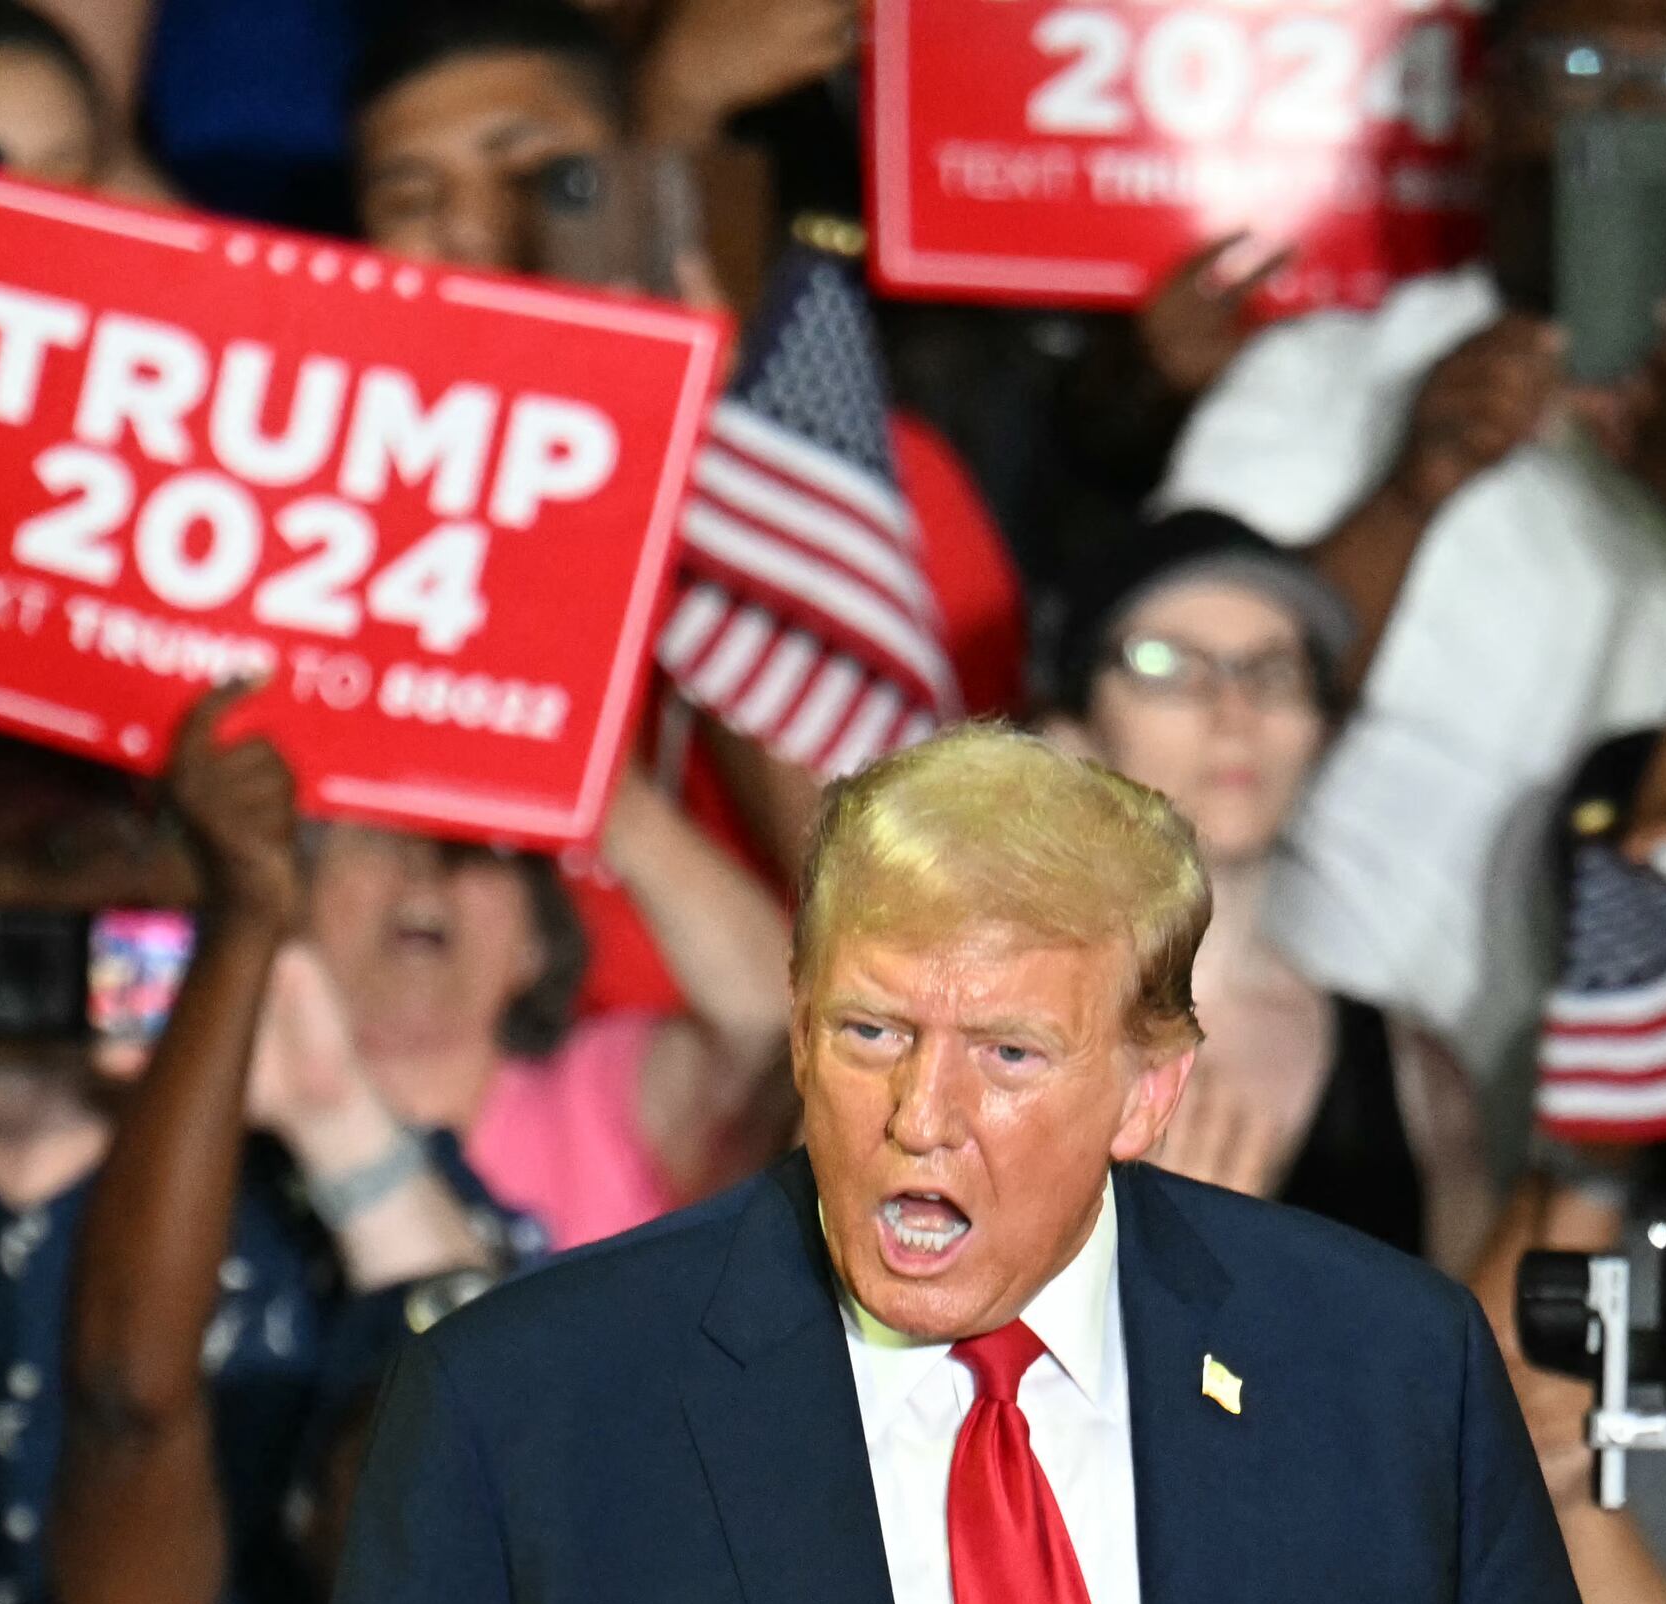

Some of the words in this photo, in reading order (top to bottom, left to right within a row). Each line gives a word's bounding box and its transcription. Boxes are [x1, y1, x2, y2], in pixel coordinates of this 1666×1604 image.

[1025, 8, 1463, 143] 2024
[11, 444, 493, 655] 2024
[291, 646, 373, 711] TO
